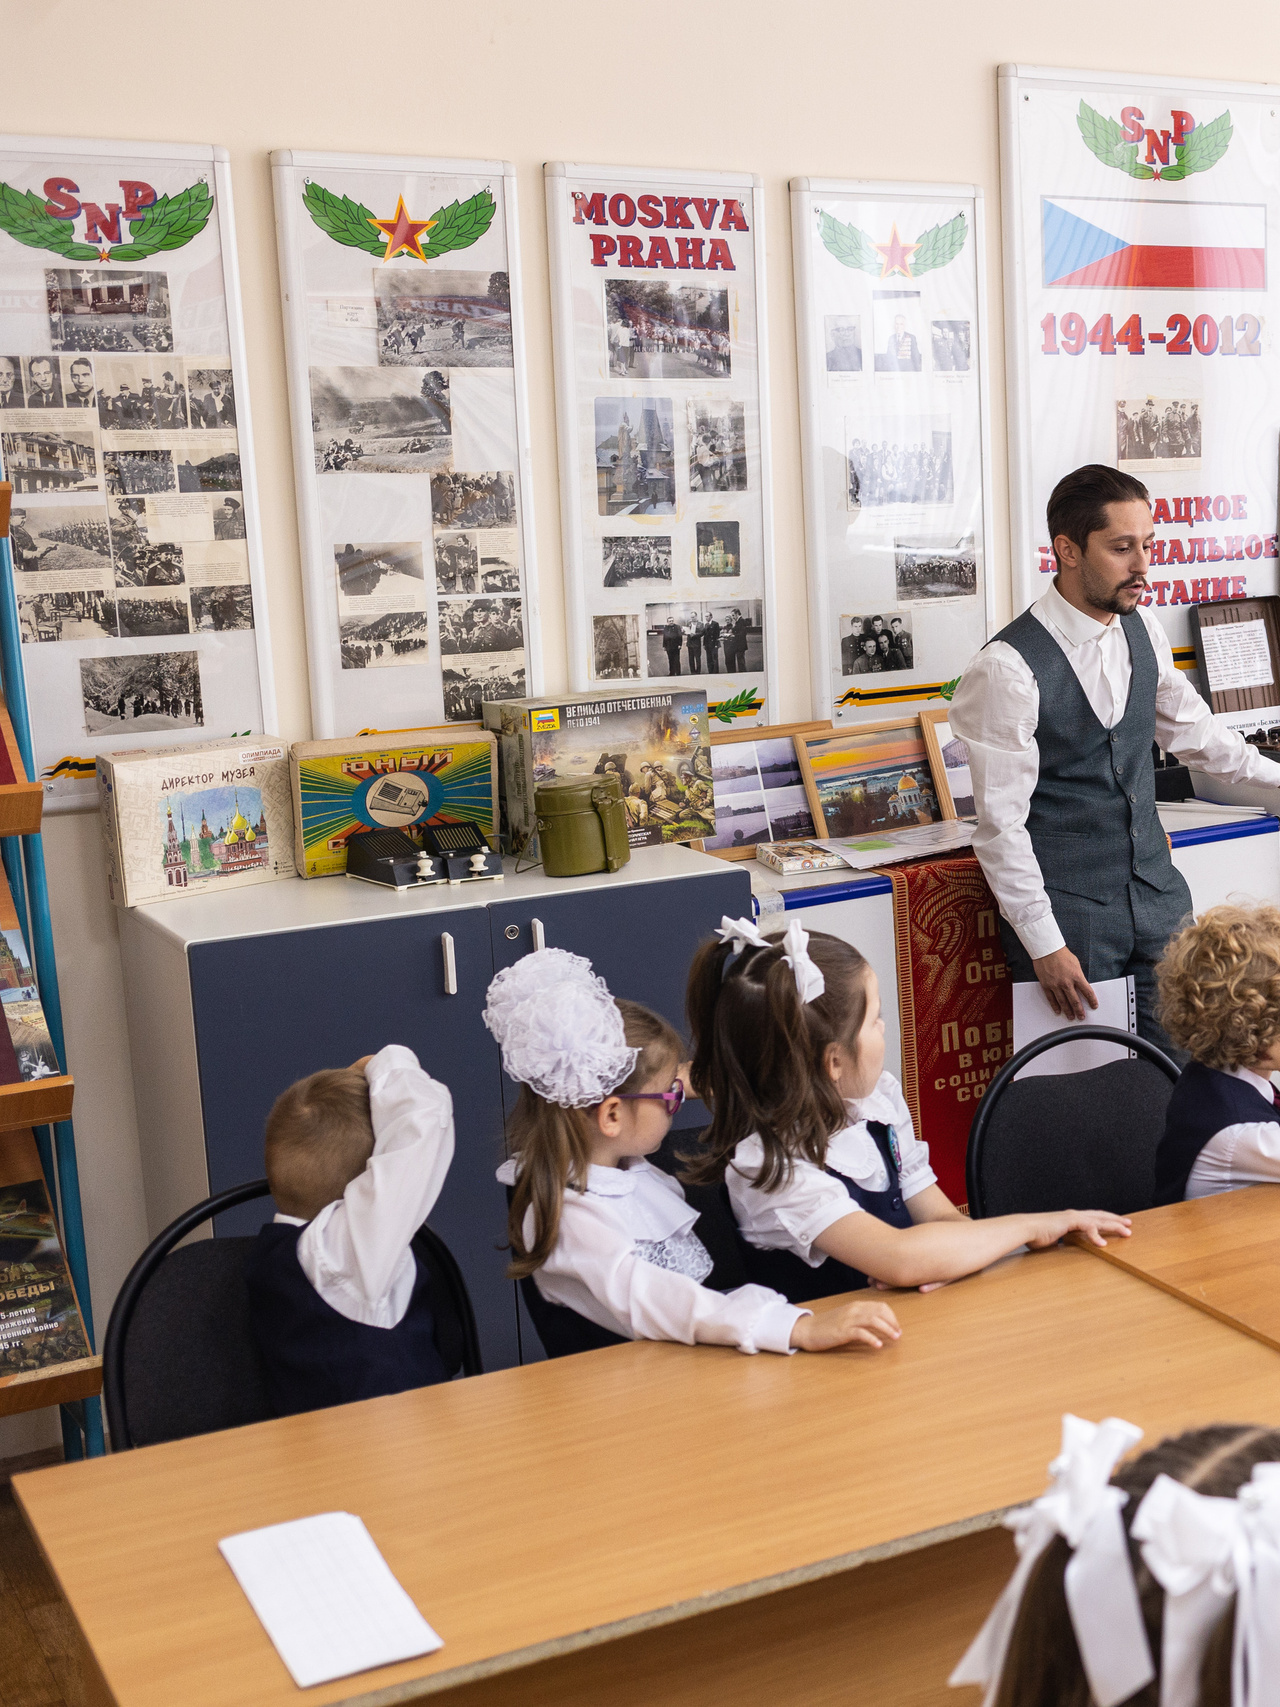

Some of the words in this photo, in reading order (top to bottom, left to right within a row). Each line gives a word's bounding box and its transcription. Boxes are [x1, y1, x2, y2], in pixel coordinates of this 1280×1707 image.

[1120, 106, 1195, 165] SNP
[43, 177, 158, 244] SNP
[571, 192, 749, 231] MOSKVA
[590, 233, 736, 271] PRAHA
[1040, 312, 1261, 356] 1944-2012
[1148, 494, 1248, 527] АЦКОЕ
[565, 701, 606, 718] ВЕЛИКАЯ
[606, 695, 672, 714] ОТЕЧЕСТВЕННАЯ
[566, 719, 584, 729] ЛЕТО
[585, 717, 600, 727] 1941
[241, 748, 282, 759] ОЛИМПИАДА
[341, 752, 453, 773] ЮНЫЙ
[161, 773, 214, 791] ДИРЕКТОР
[221, 767, 255, 783] МУЗЕЯ
[34, 1321, 59, 1333] войне
